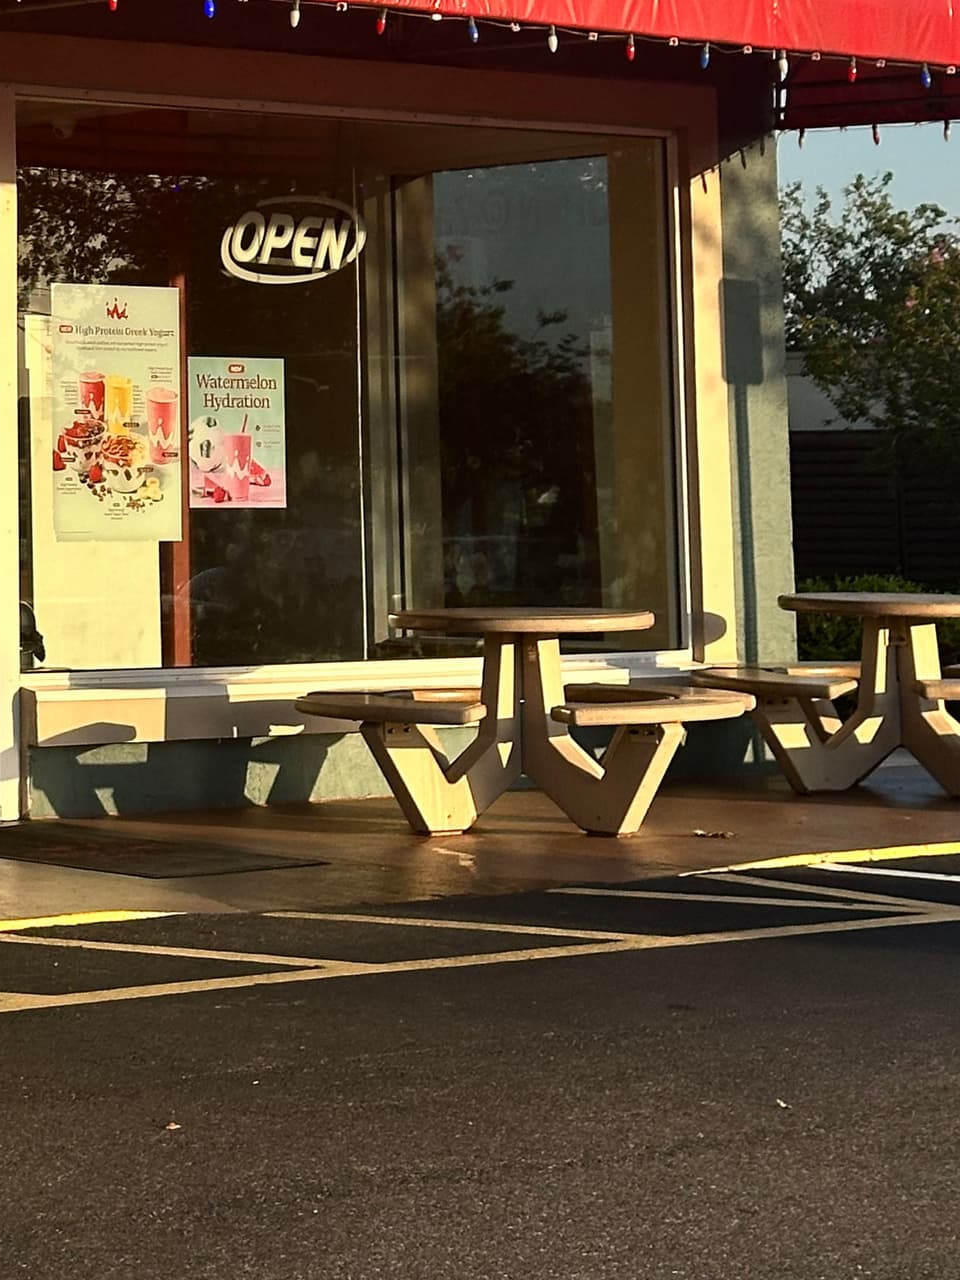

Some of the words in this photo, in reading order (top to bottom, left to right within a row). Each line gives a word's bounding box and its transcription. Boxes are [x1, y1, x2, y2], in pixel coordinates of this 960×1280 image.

[231, 210, 351, 270] OPEN
[196, 373, 277, 390] Watermelon
[203, 393, 270, 412] Hydration
